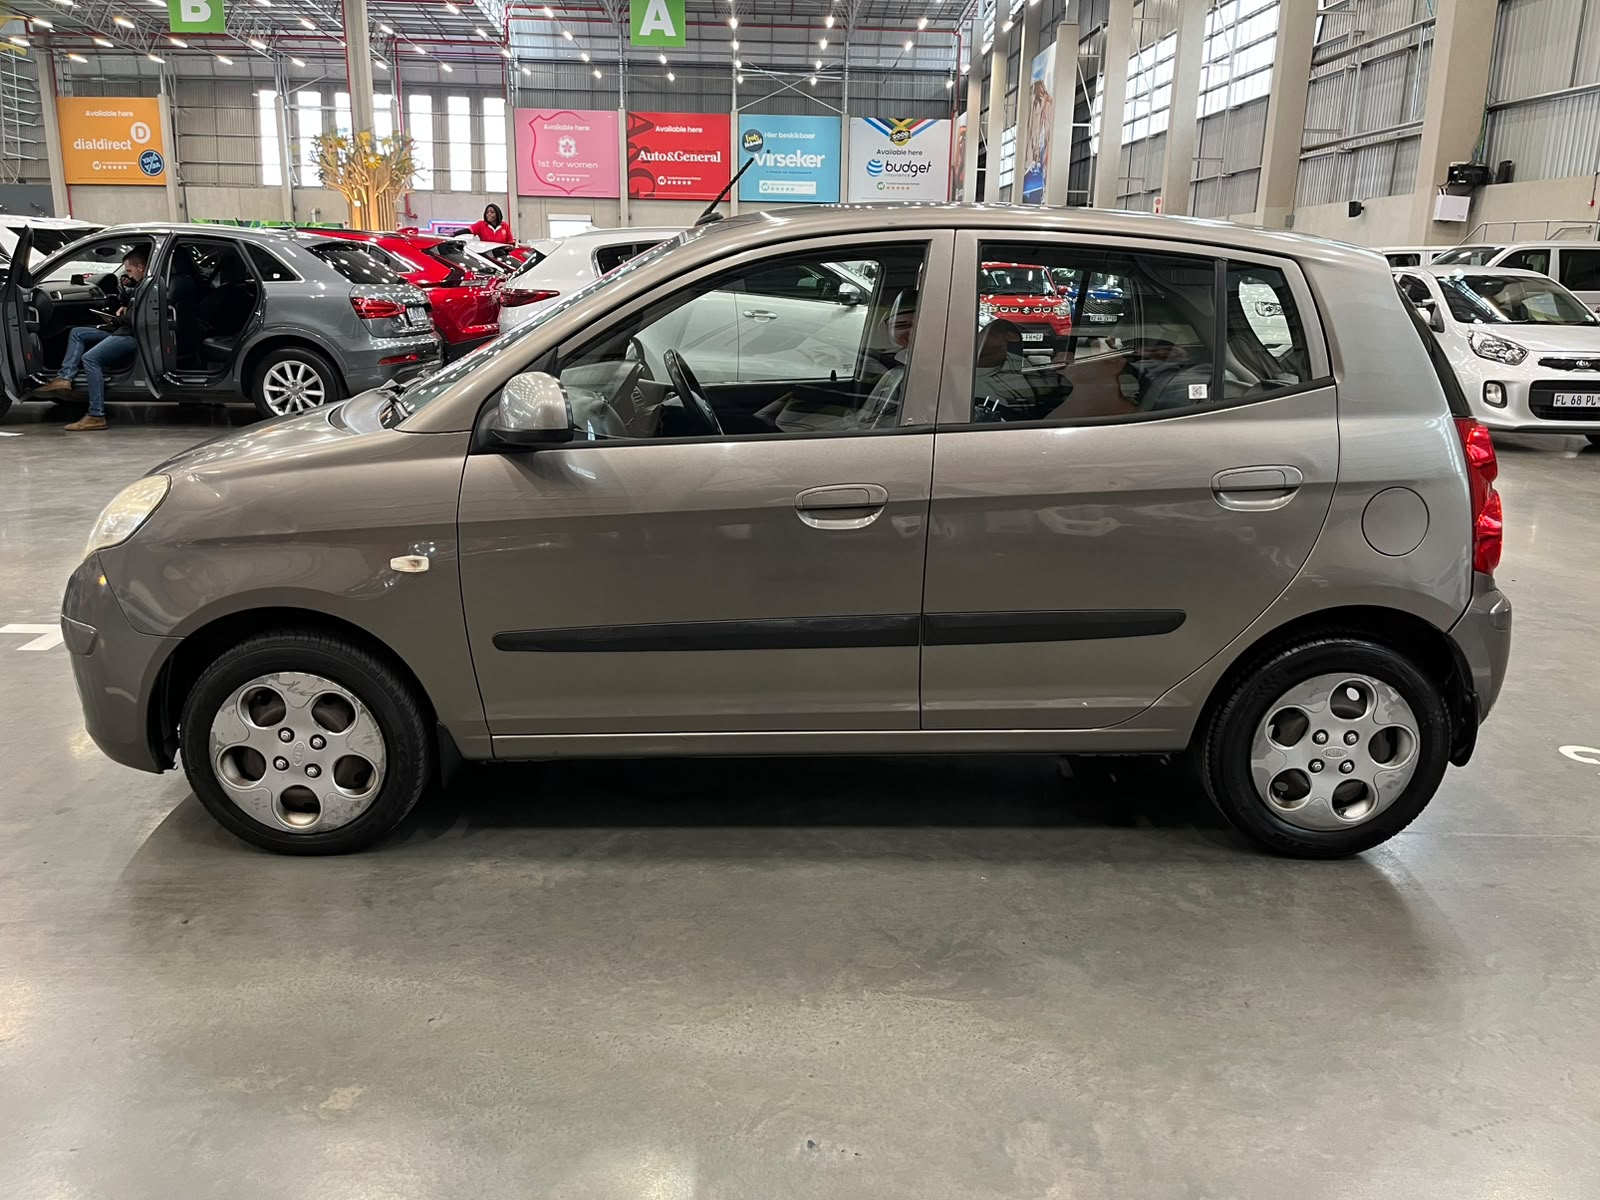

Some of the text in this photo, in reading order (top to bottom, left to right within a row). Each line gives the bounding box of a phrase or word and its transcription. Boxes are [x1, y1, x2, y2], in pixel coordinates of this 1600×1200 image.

[180, 0, 211, 23] B
[639, 0, 677, 37] A
[543, 123, 574, 131] Available
[655, 125, 687, 133] Available
[764, 131, 816, 139] Hier beskikbaar
[74, 139, 132, 150] dialdirect
[638, 150, 721, 162] Auto&General
[754, 149, 826, 168] virseker
[538, 160, 551, 168] 1st
[552, 160, 565, 168] for
[885, 160, 932, 178] budget
[1555, 395, 1596, 406] FL 68 PL
